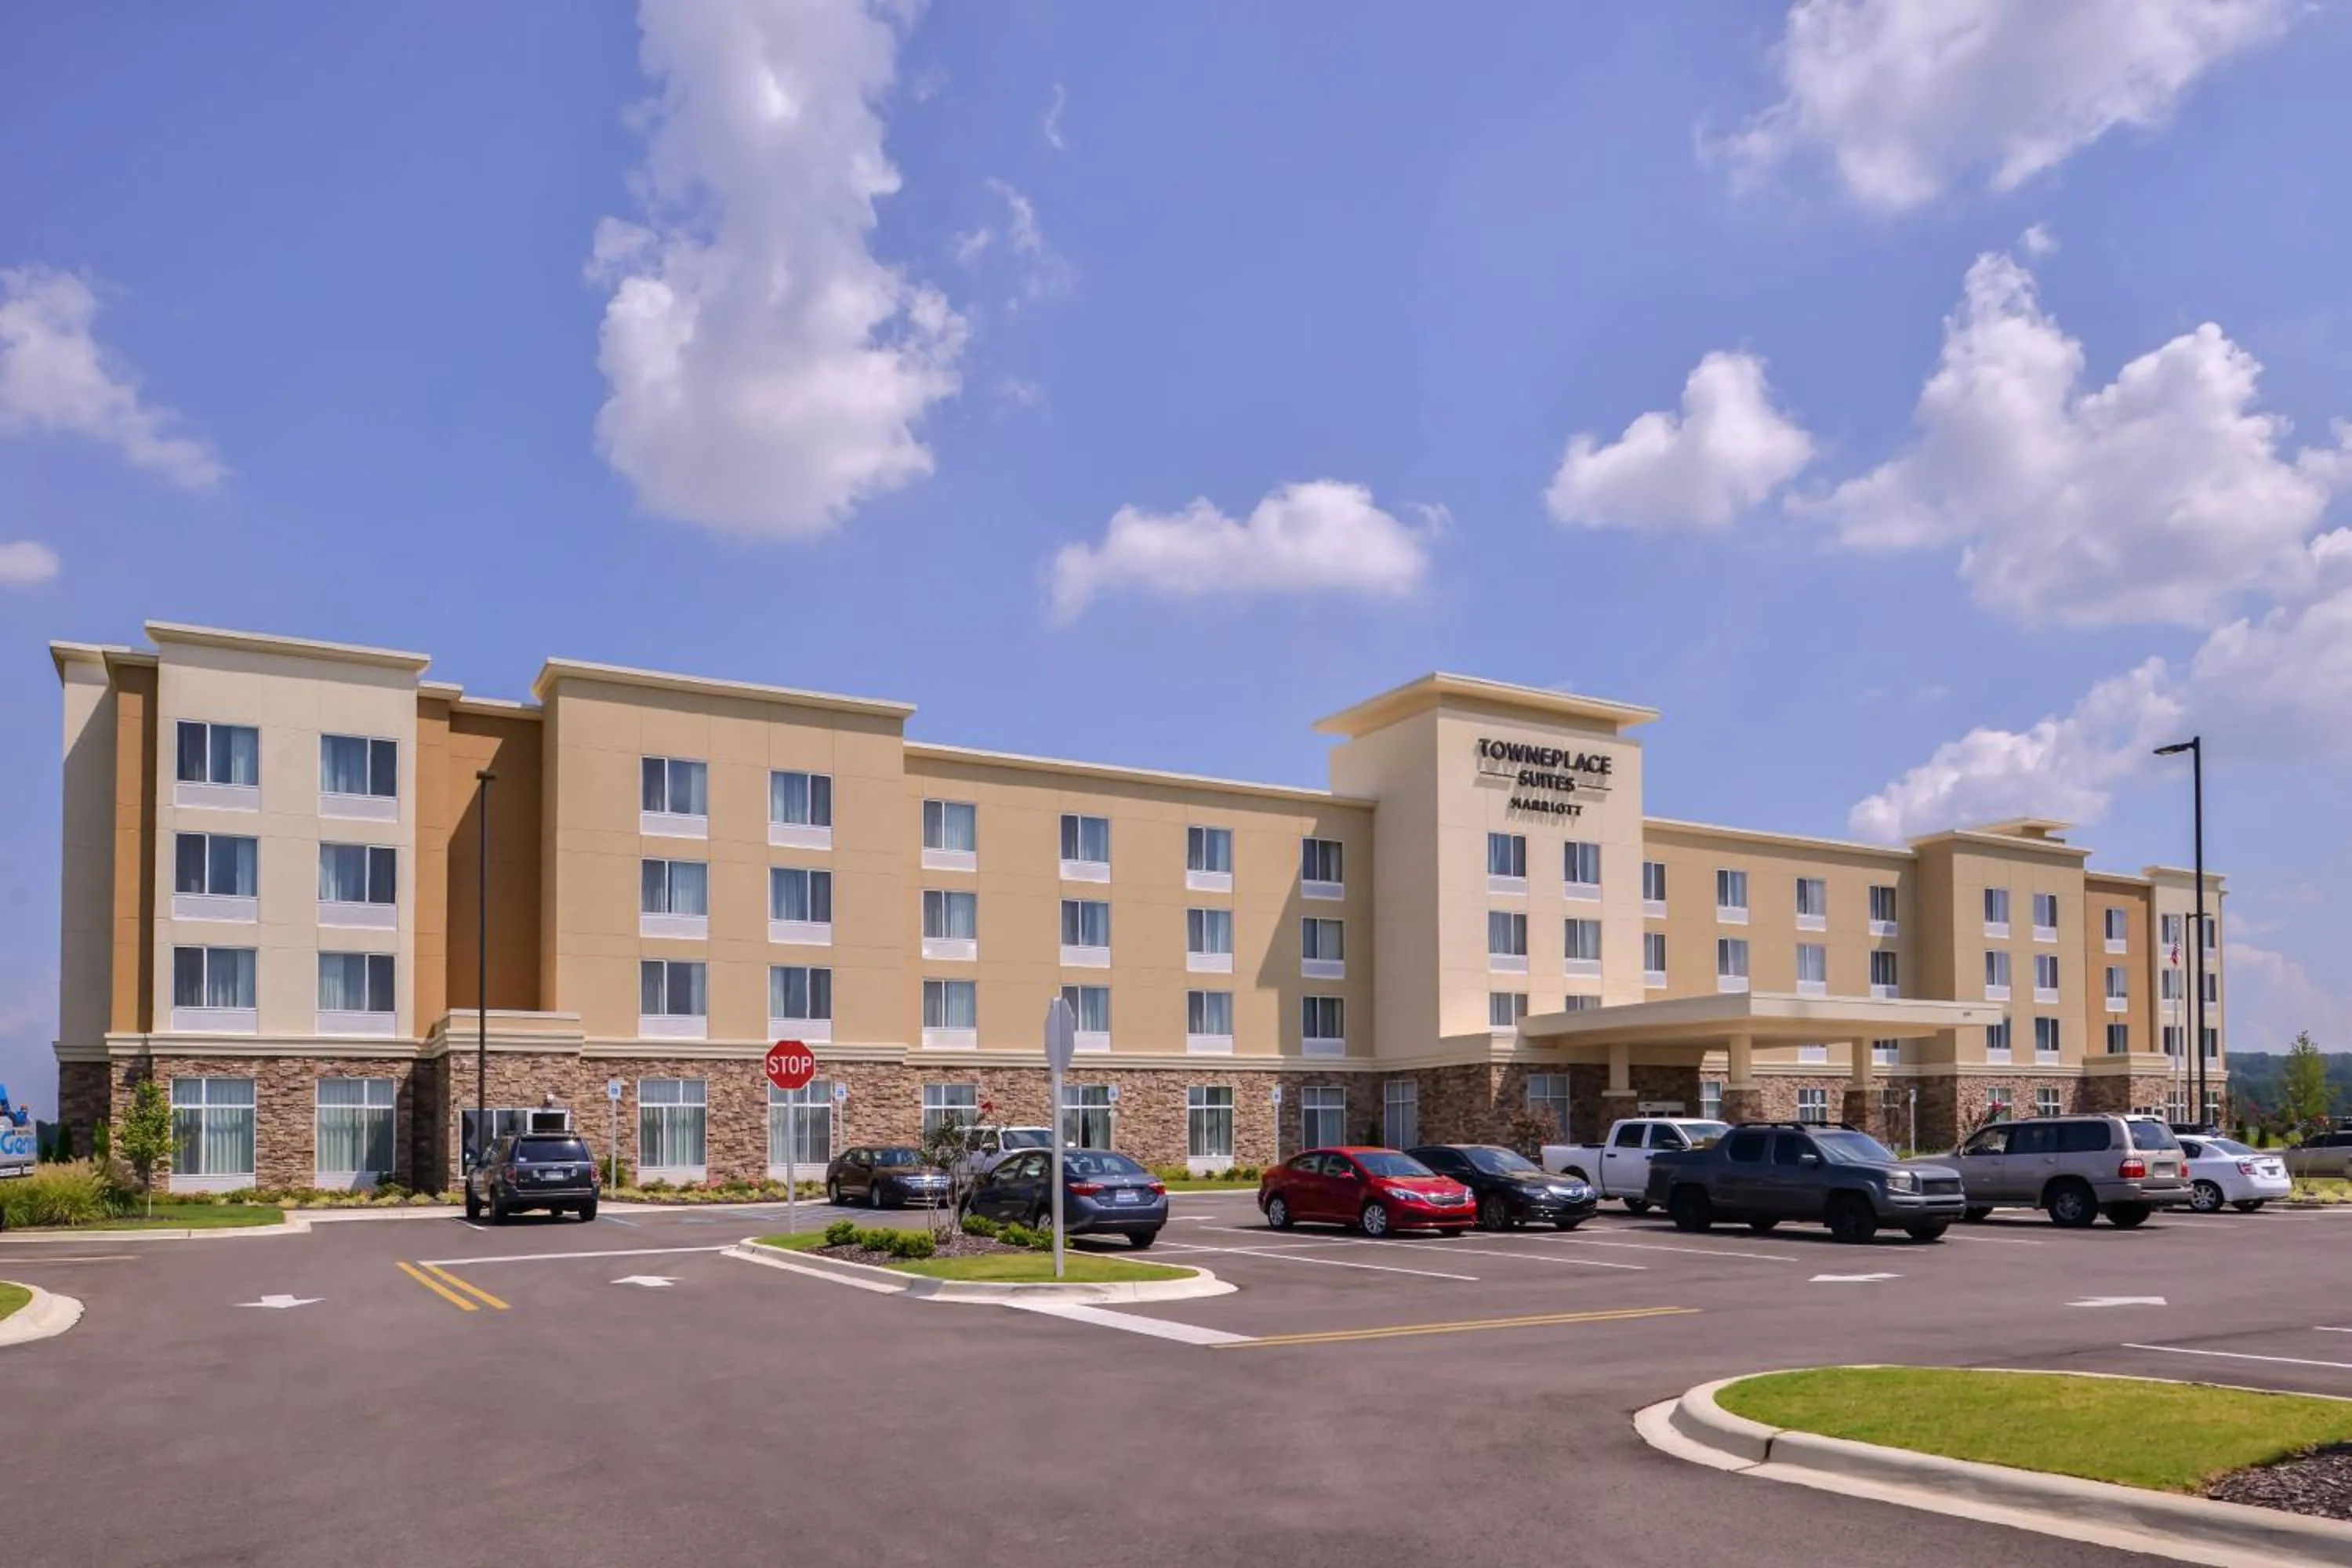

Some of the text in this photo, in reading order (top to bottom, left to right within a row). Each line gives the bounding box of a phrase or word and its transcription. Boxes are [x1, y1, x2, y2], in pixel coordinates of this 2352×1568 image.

[1478, 738, 1612, 775] TOWNEPLACE
[1518, 770, 1576, 791] SUITES
[1510, 797, 1583, 816] MARRIOTT
[768, 1055, 812, 1075] STOP
